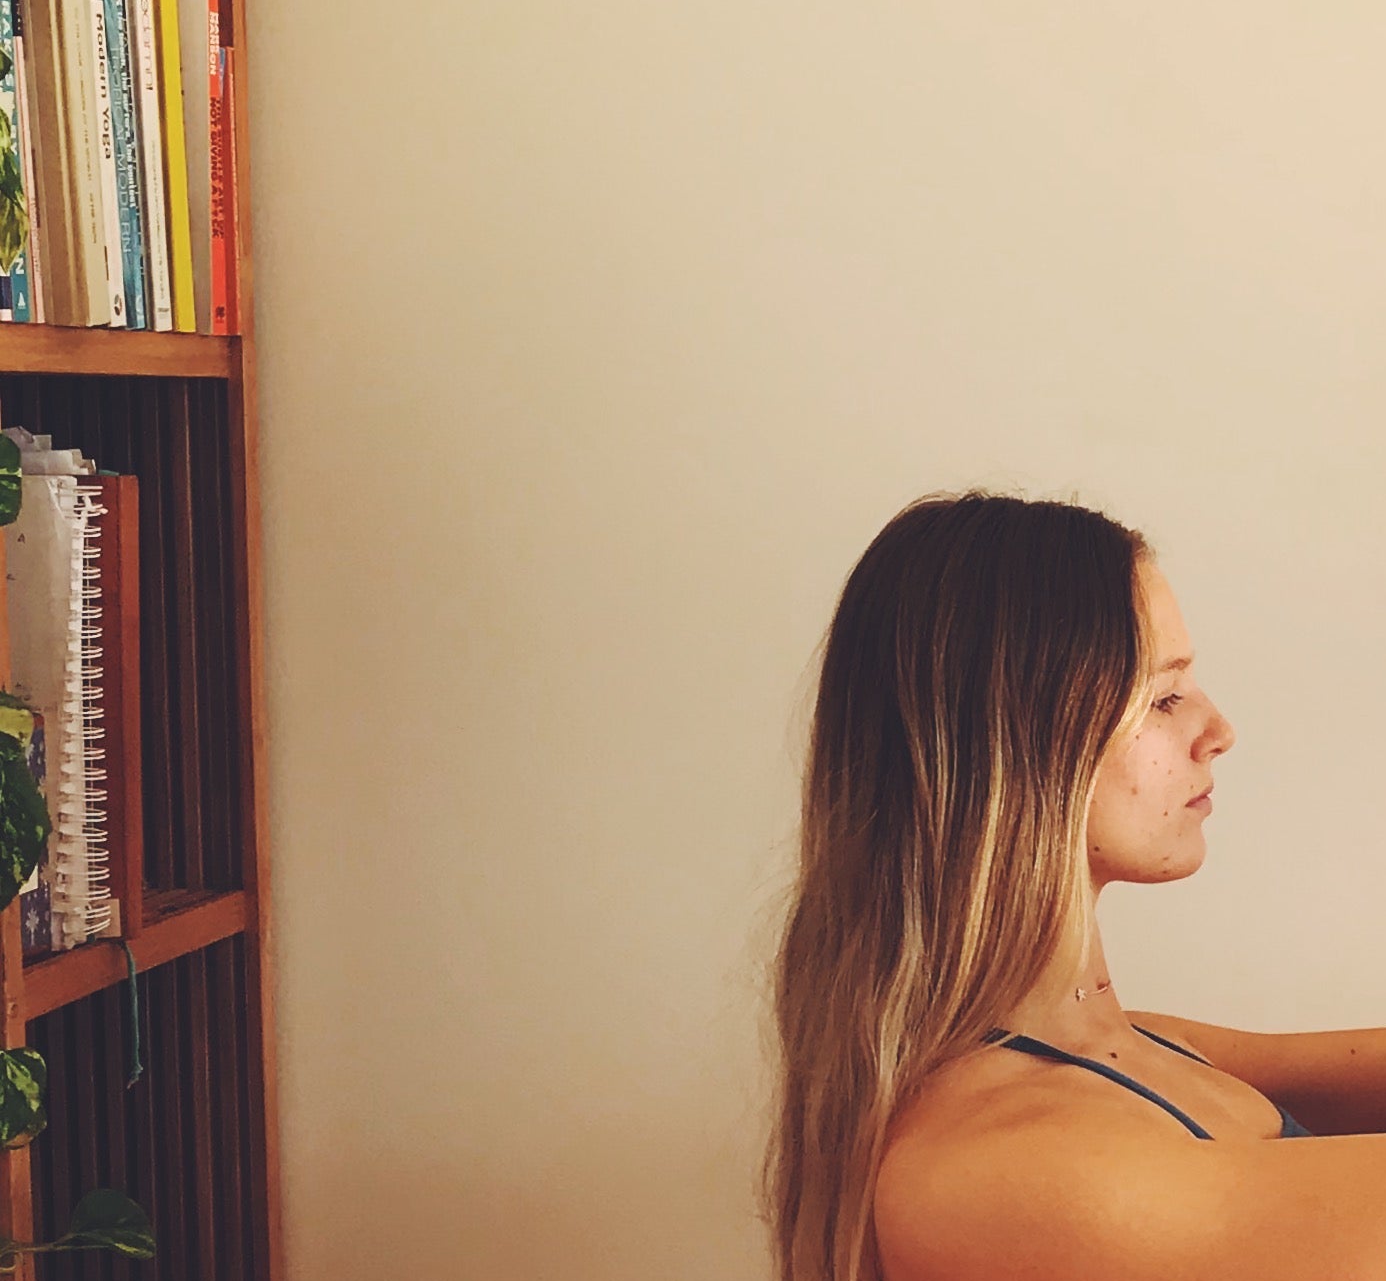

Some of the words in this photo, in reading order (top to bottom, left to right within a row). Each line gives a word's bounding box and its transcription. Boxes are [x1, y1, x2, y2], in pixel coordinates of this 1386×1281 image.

[96, 12, 107, 99] Modern
[102, 107, 111, 160] Yoga
[116, 152, 132, 253] MODERN
